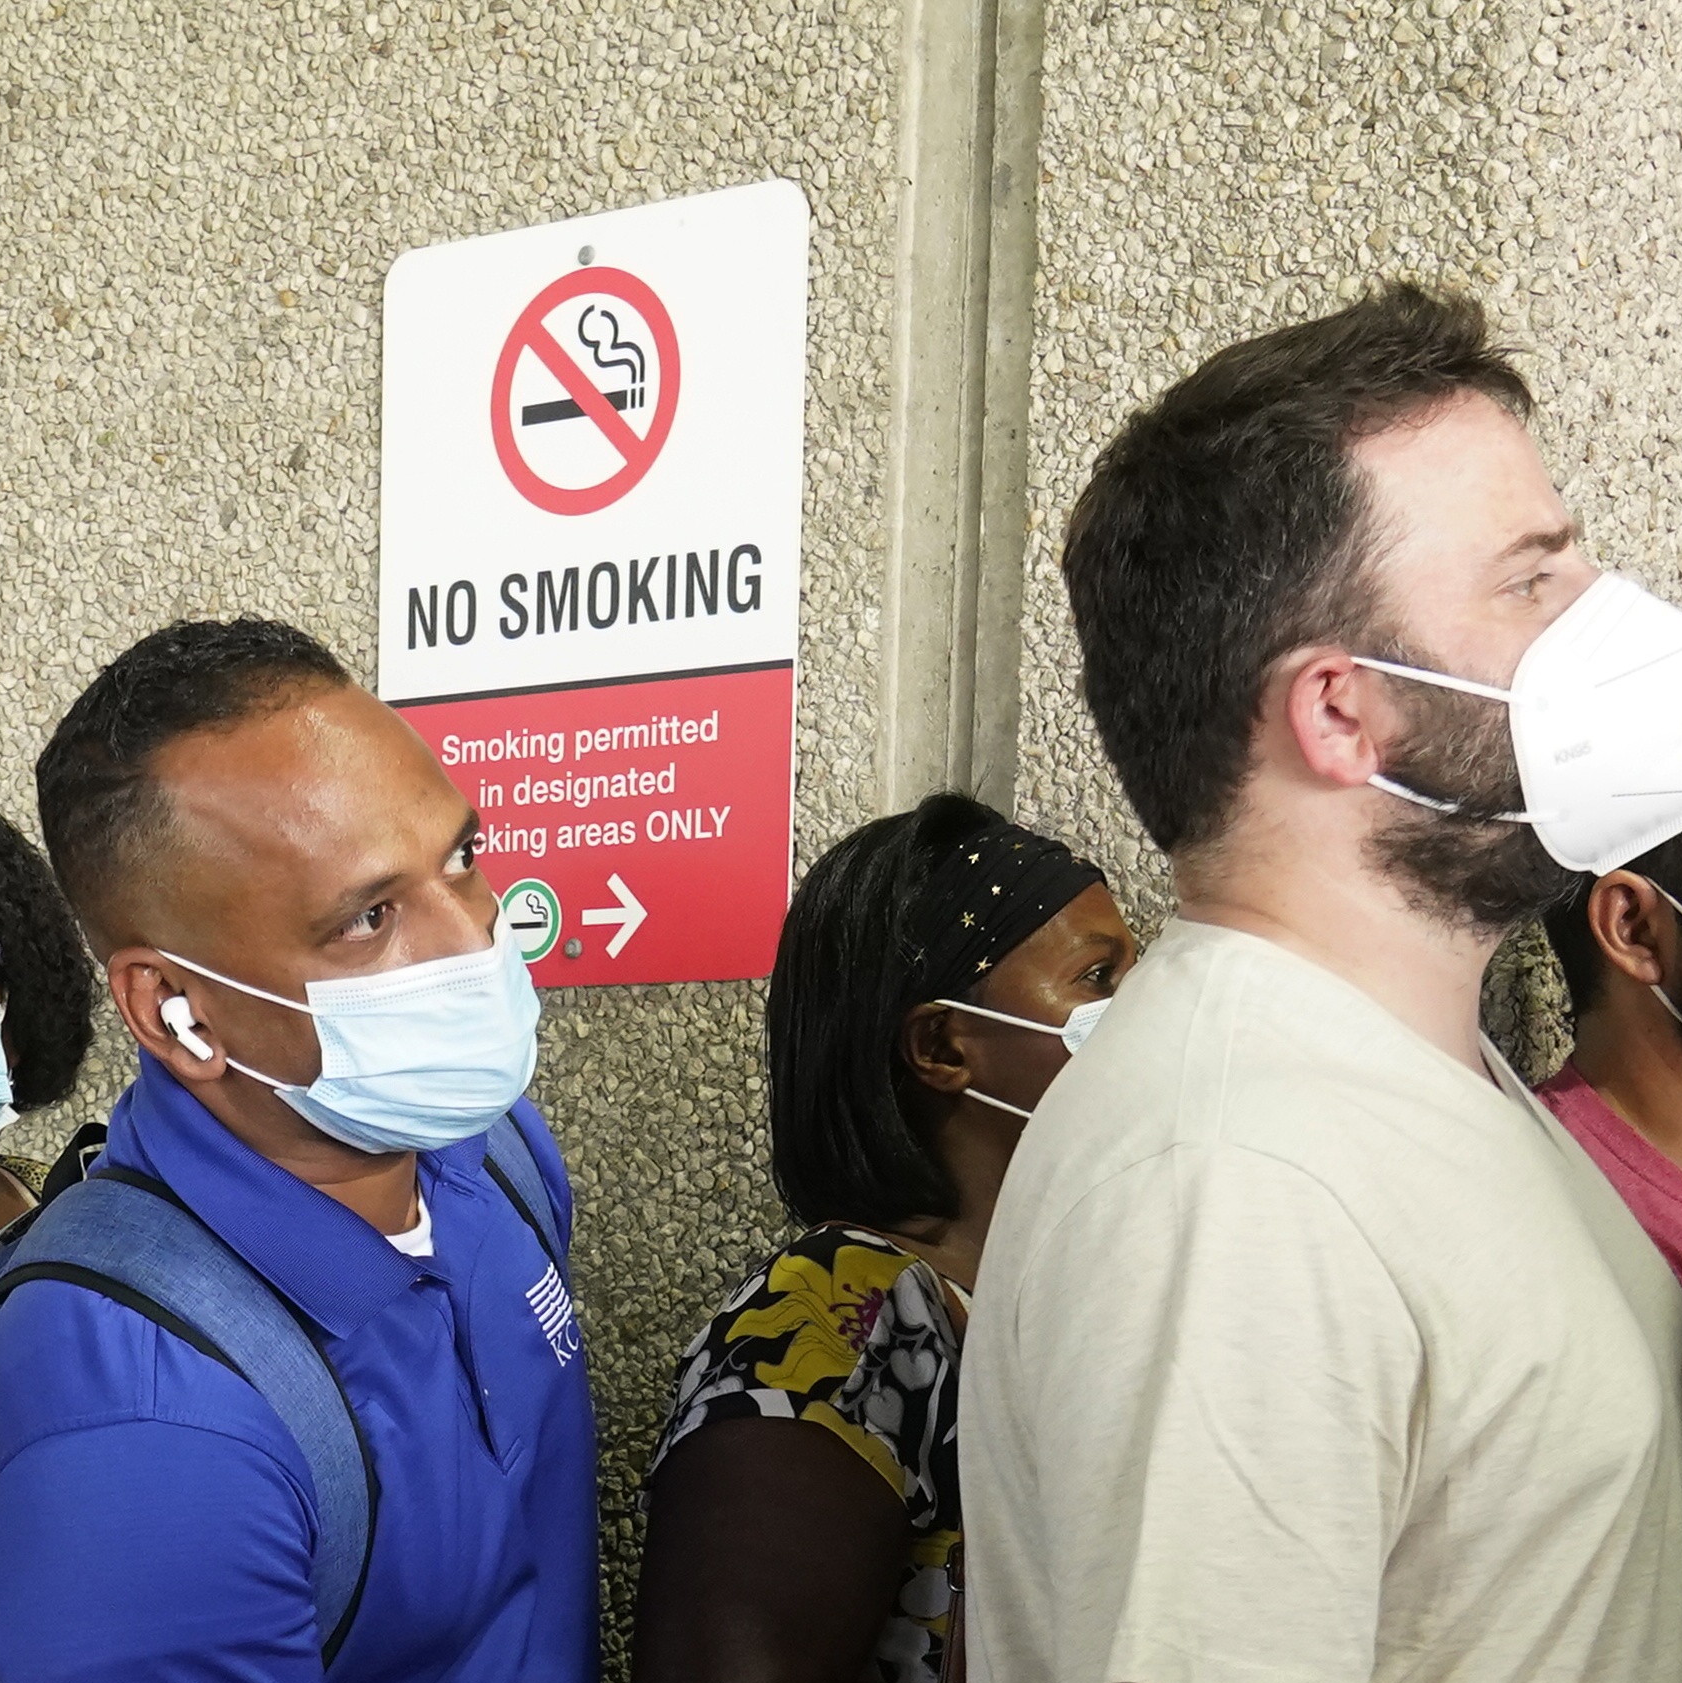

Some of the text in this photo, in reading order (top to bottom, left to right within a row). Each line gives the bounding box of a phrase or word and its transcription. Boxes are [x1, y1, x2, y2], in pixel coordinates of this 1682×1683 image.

[406, 542, 763, 651] NO SMOKING
[441, 709, 719, 766] Smoking permitted
[479, 761, 676, 809] in designated
[472, 805, 732, 858] oking areas ONLY
